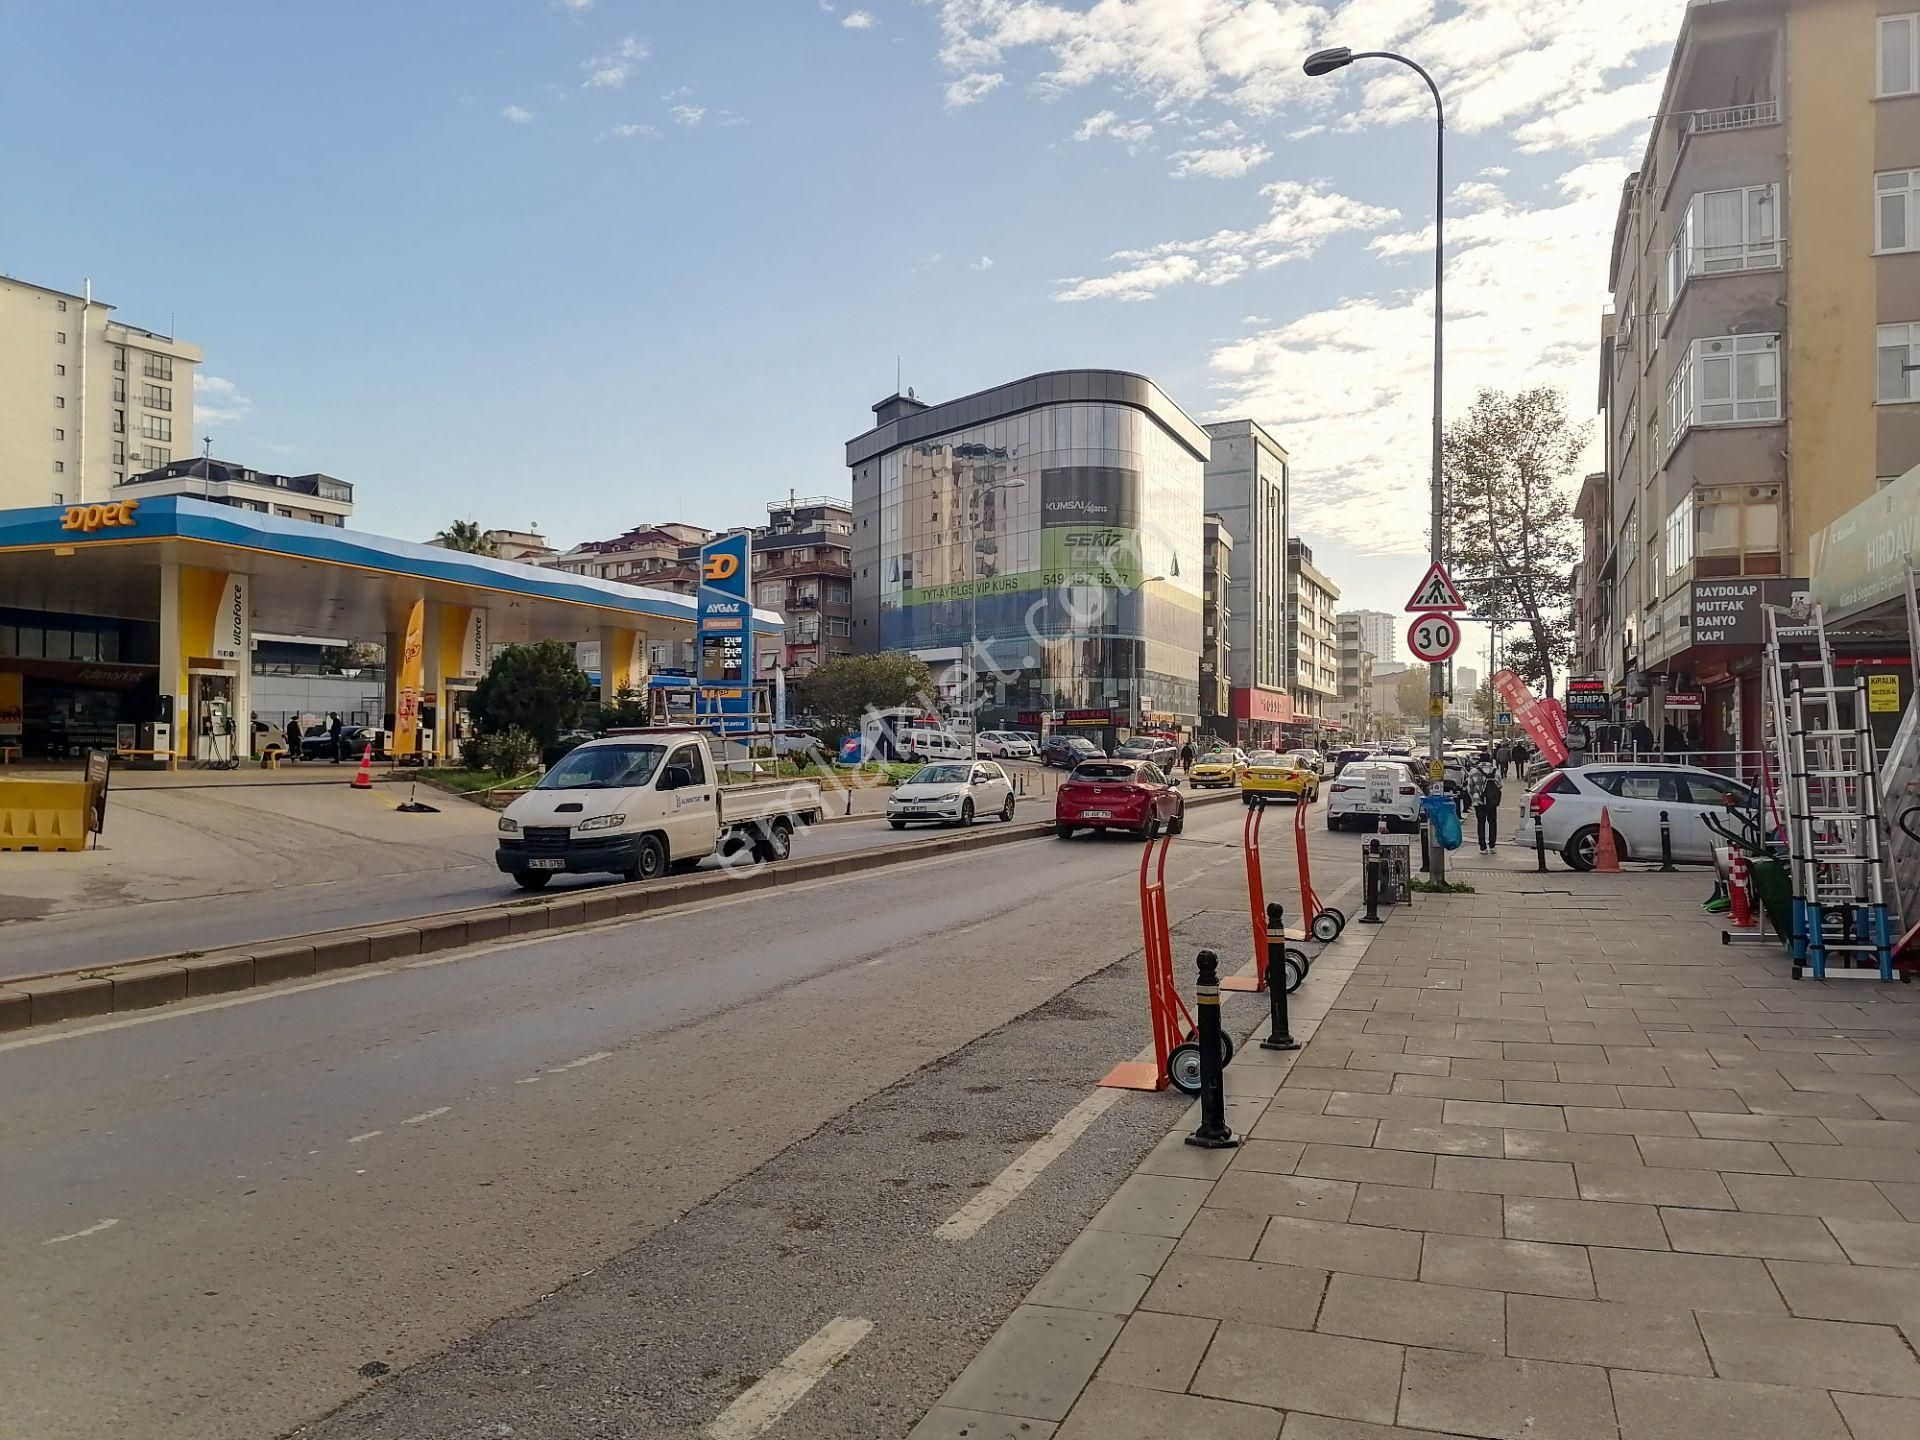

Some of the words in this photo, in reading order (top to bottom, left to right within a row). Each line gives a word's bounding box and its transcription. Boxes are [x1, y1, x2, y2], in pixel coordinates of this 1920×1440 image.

[60, 499, 140, 532] opet
[1043, 574, 1065, 586] 549
[1097, 572, 1112, 585] 55
[976, 582, 992, 594] VIP
[992, 578, 1019, 591] KURS
[1696, 586, 1758, 598] RAYDOLAP
[706, 603, 740, 613] AYGAZ
[1696, 600, 1745, 613] MUTFAK
[232, 584, 242, 646] ultraforce
[1696, 615, 1737, 627] BANYO
[1418, 625, 1450, 649] 30
[1696, 630, 1725, 641] KAPI
[1569, 695, 1606, 704] DEMPA
